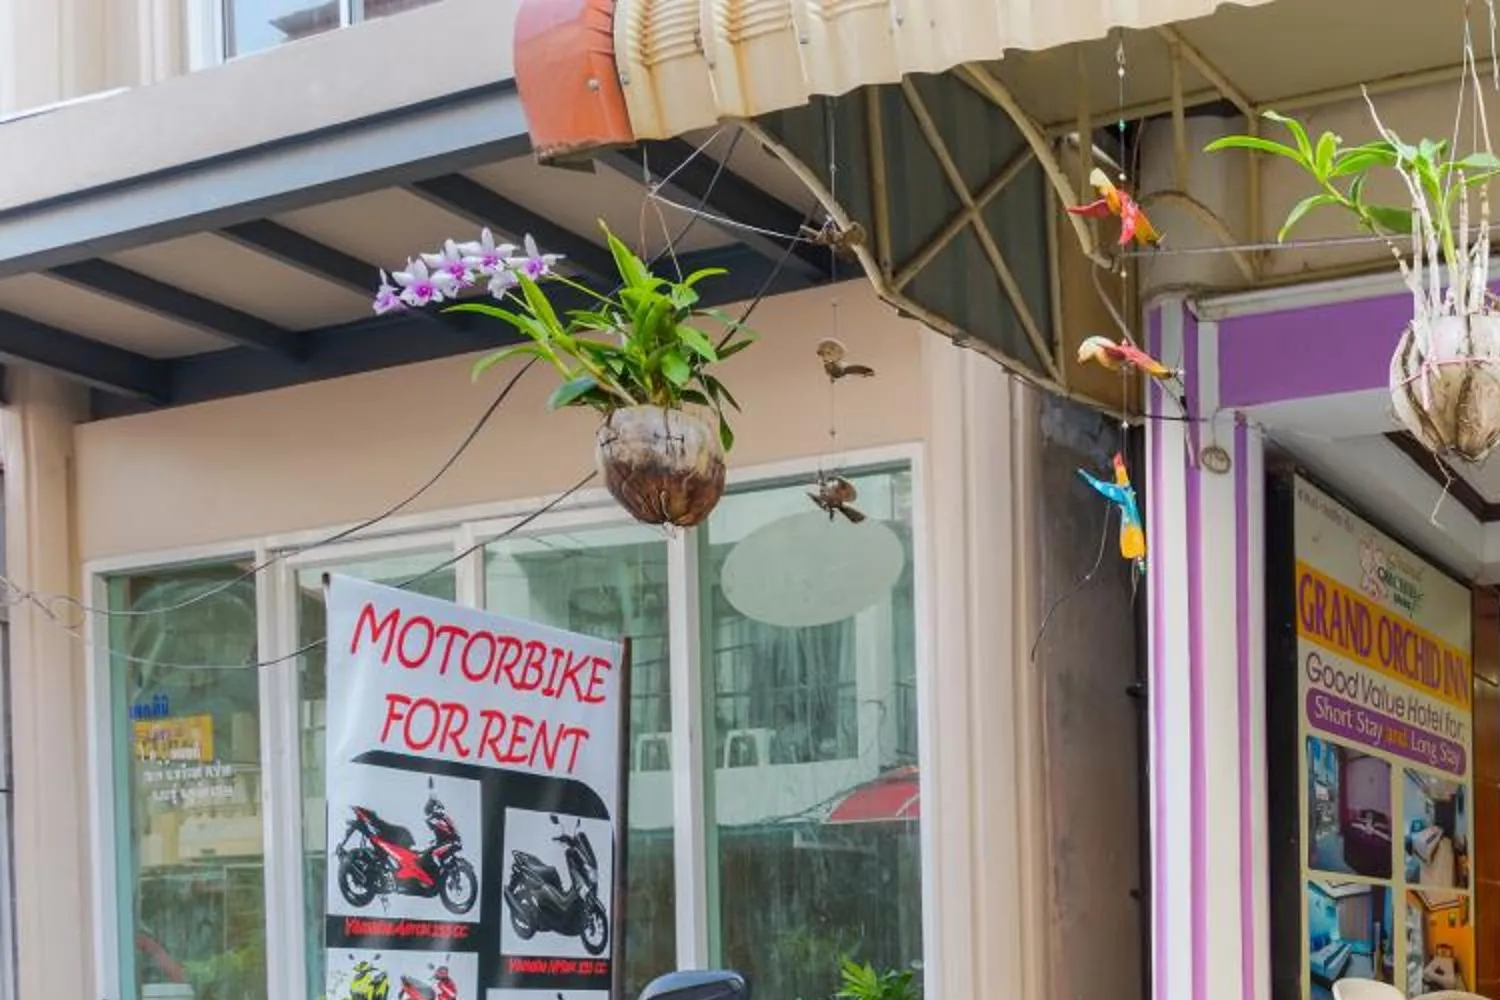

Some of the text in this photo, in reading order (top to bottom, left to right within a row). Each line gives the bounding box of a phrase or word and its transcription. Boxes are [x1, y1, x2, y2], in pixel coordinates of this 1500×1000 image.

[351, 603, 612, 703] MOTORBIKE
[1300, 573, 1373, 658] GRAND
[1377, 615, 1441, 689] ORCHID
[1443, 648, 1469, 705] INN
[1306, 652, 1359, 699] Good
[1362, 673, 1405, 718] Value
[1407, 696, 1443, 731] Hotel
[380, 693, 590, 774] FOR RENT
[1315, 695, 1354, 729] Short
[1356, 711, 1384, 745] Stay
[1411, 730, 1437, 766] Long
[1439, 741, 1461, 771] Stay
